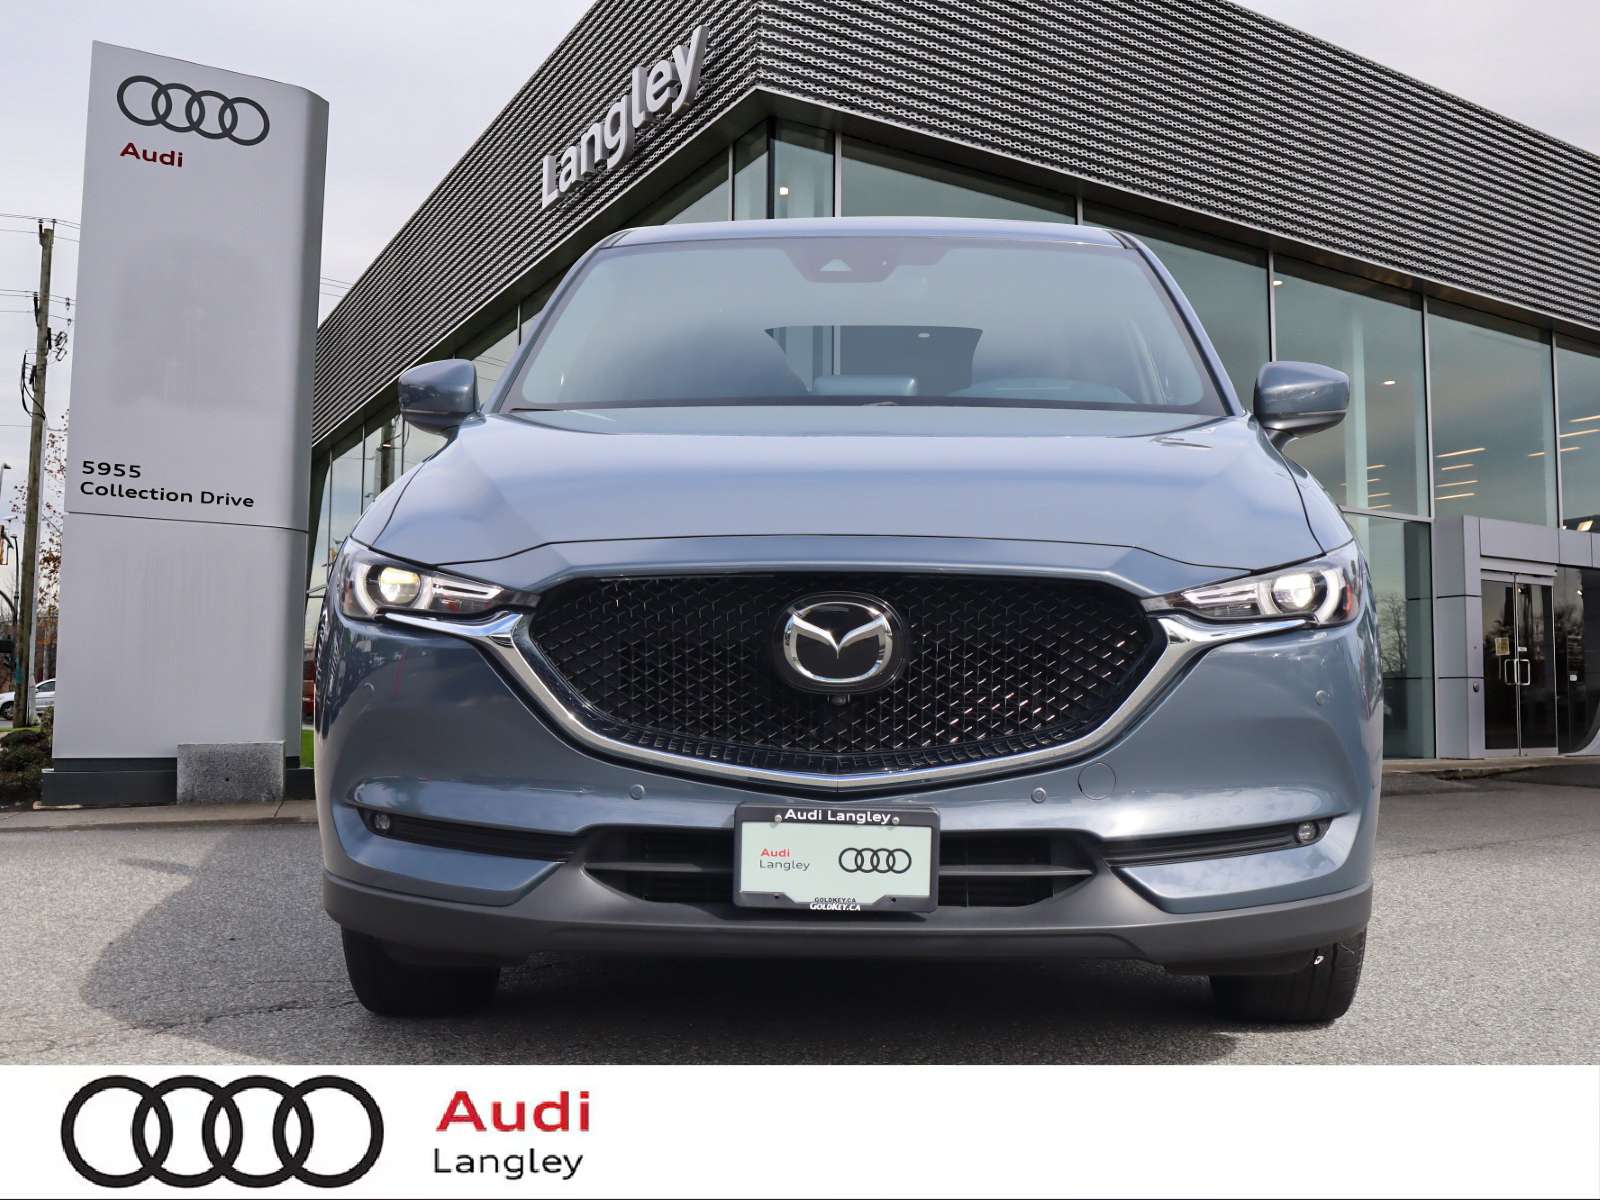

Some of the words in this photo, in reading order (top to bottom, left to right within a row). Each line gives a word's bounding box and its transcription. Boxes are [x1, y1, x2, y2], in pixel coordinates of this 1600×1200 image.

[541, 24, 710, 210] Langley
[120, 142, 183, 167] Audi
[82, 460, 142, 478] 5955
[80, 481, 193, 503] Collection
[200, 491, 255, 507] Drive
[784, 808, 822, 821] Audi
[827, 809, 891, 825] Langley
[760, 848, 790, 858] Audi
[759, 859, 811, 872] Langley
